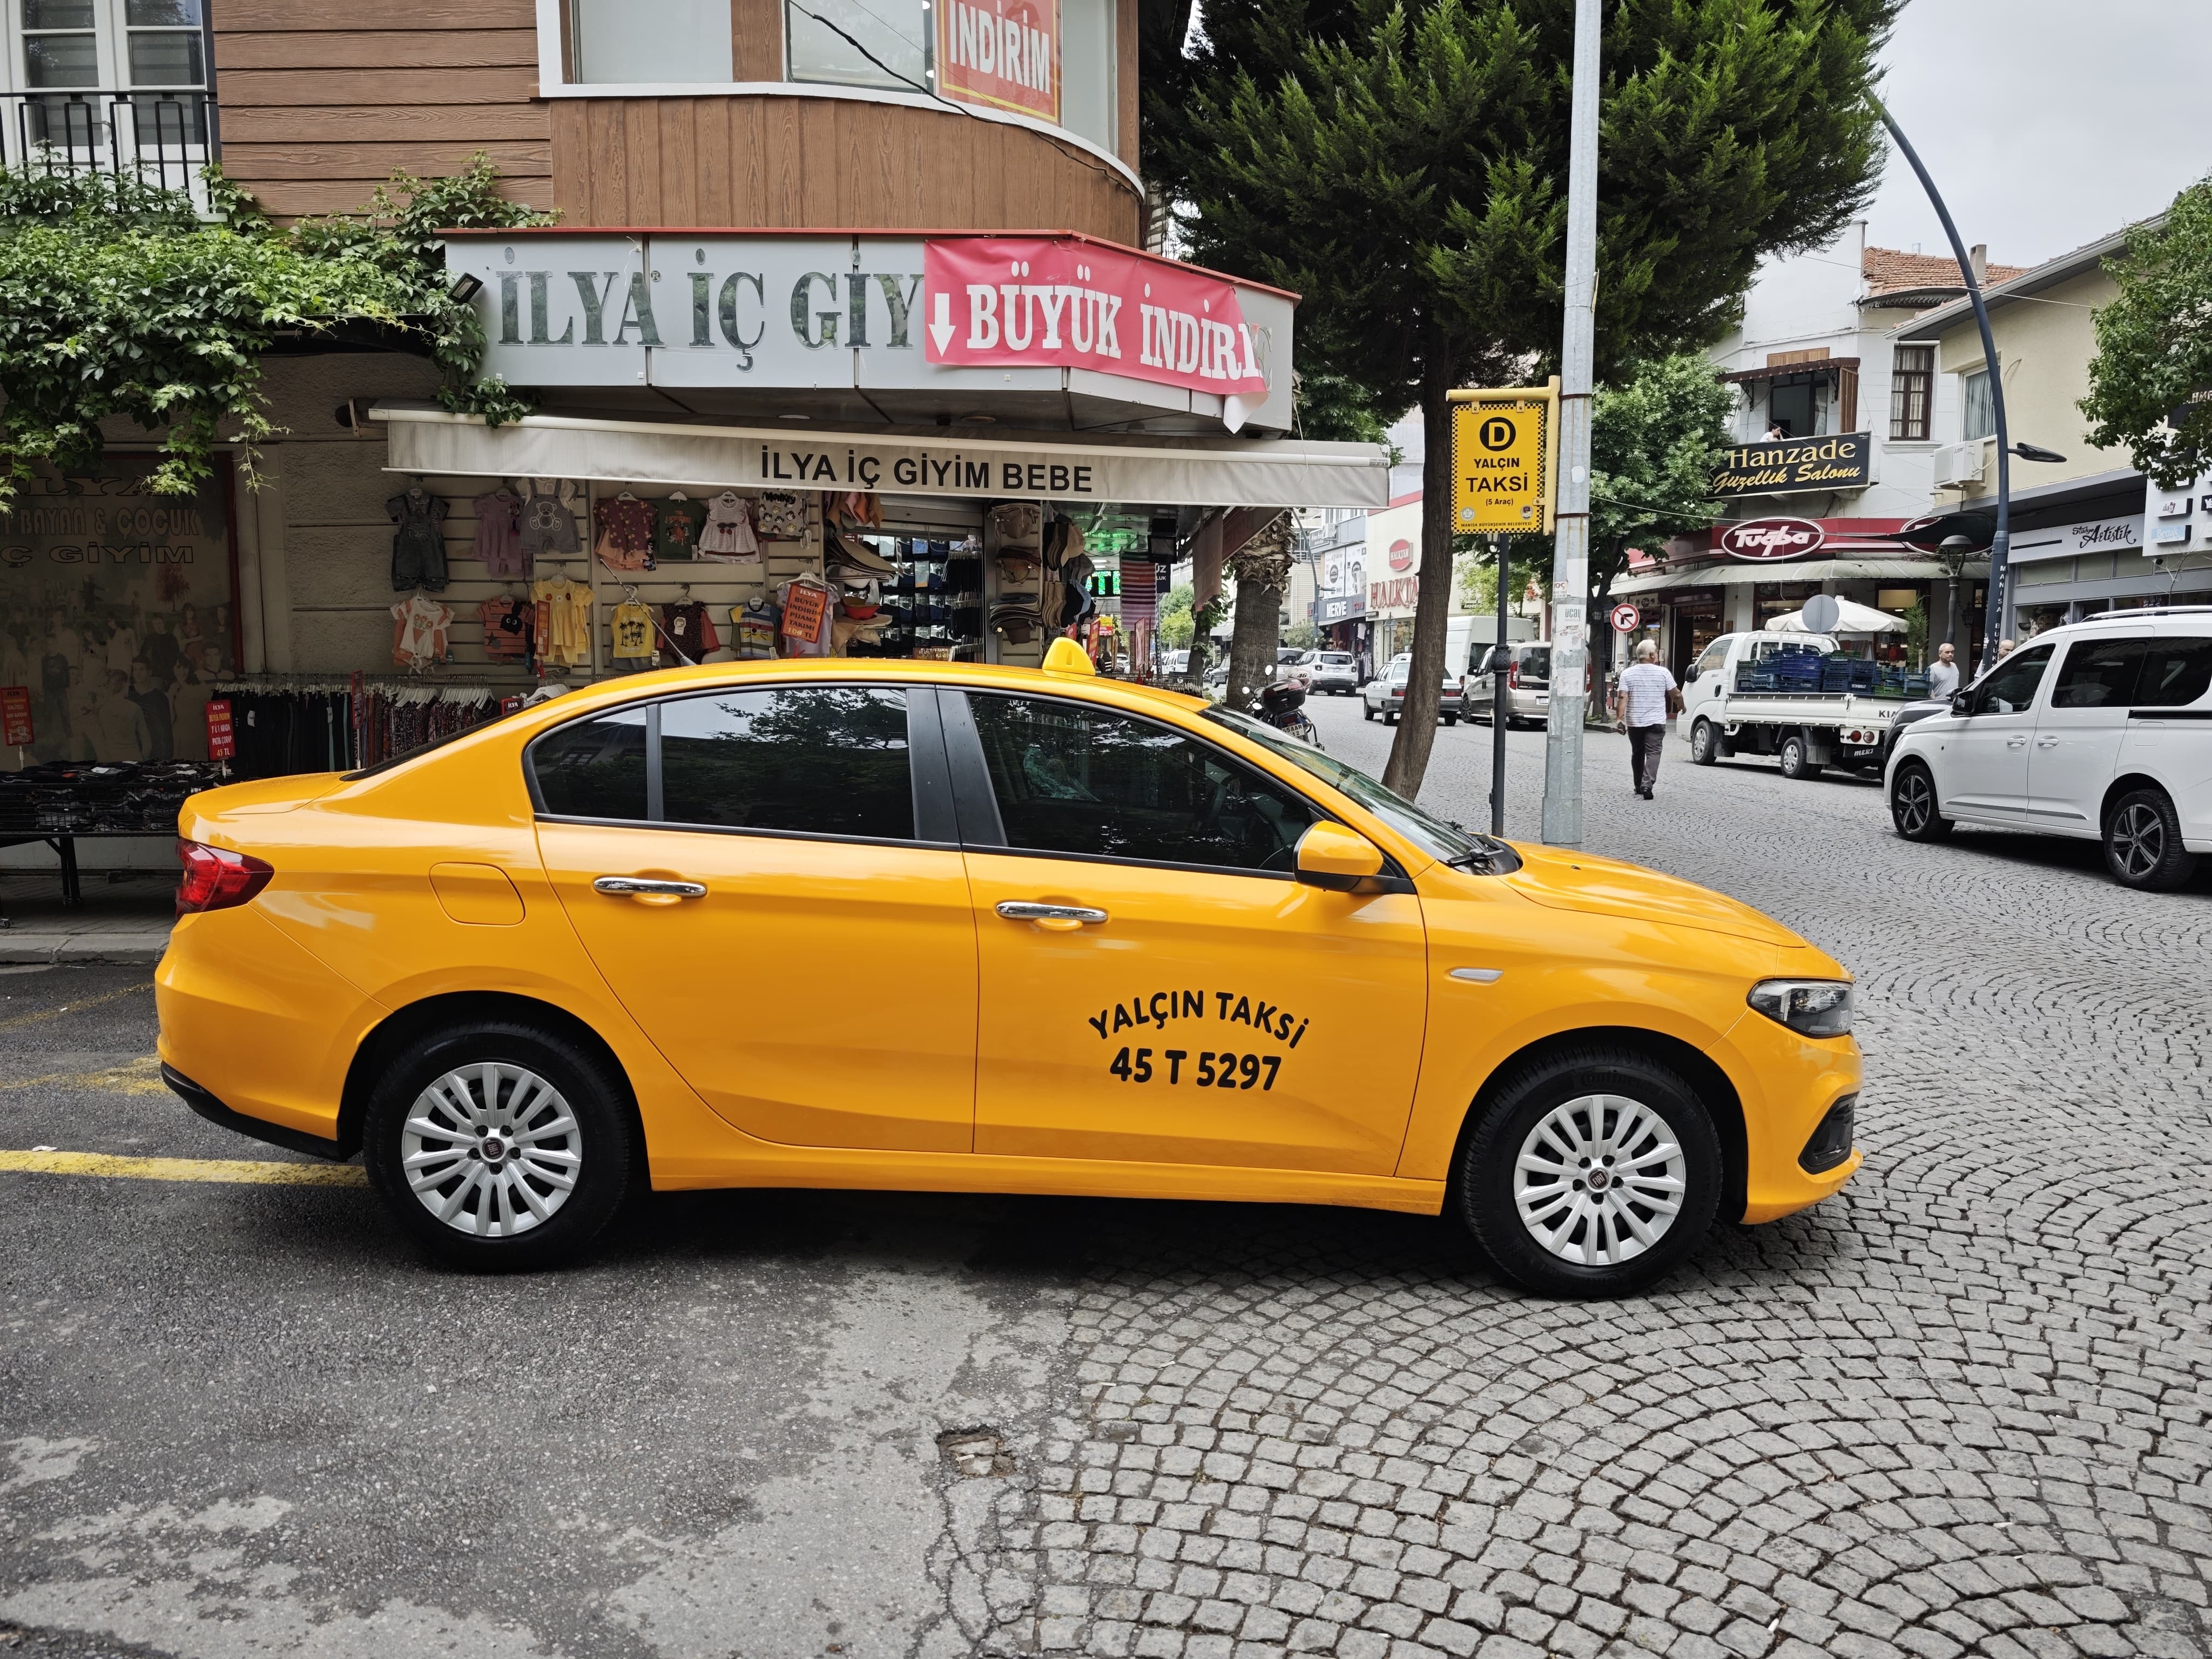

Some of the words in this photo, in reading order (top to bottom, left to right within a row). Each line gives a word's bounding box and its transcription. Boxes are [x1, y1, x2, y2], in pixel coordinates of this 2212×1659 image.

[496, 247, 665, 347] İLYA
[687, 248, 765, 373] İÇ
[791, 248, 924, 350] GİY
[967, 261, 1121, 359] BÜYÜK
[1474, 458, 1520, 471] YALÇIN
[1729, 440, 1857, 469] Hanzade
[761, 445, 835, 481] İLYA
[848, 449, 881, 489] İÇ
[894, 453, 989, 488] GİYİM
[1003, 463, 1091, 493] BEBE
[1795, 463, 1860, 482] Salonu
[1466, 472, 1528, 492] TAKSİ
[116, 507, 200, 540] ÇOCUK
[0, 546, 32, 567] Ç
[49, 542, 194, 564] GİYİM
[795, 596, 819, 608] BÜYÜK
[800, 588, 817, 598] İLYA
[1370, 576, 1419, 609] HALKTA
[790, 603, 821, 616] İNDİRİM
[1326, 601, 1347, 618] MERVE
[789, 619, 814, 631] TAKIMI
[224, 747, 230, 756] TL
[1089, 990, 1204, 1040] YALÇIN
[1216, 992, 1309, 1049] TAKSİ
[1110, 1047, 1152, 1083] 45
[1165, 1049, 1188, 1084] T
[1196, 1051, 1282, 1090] 5297
[1592, 1172, 1605, 1186] FIAT
